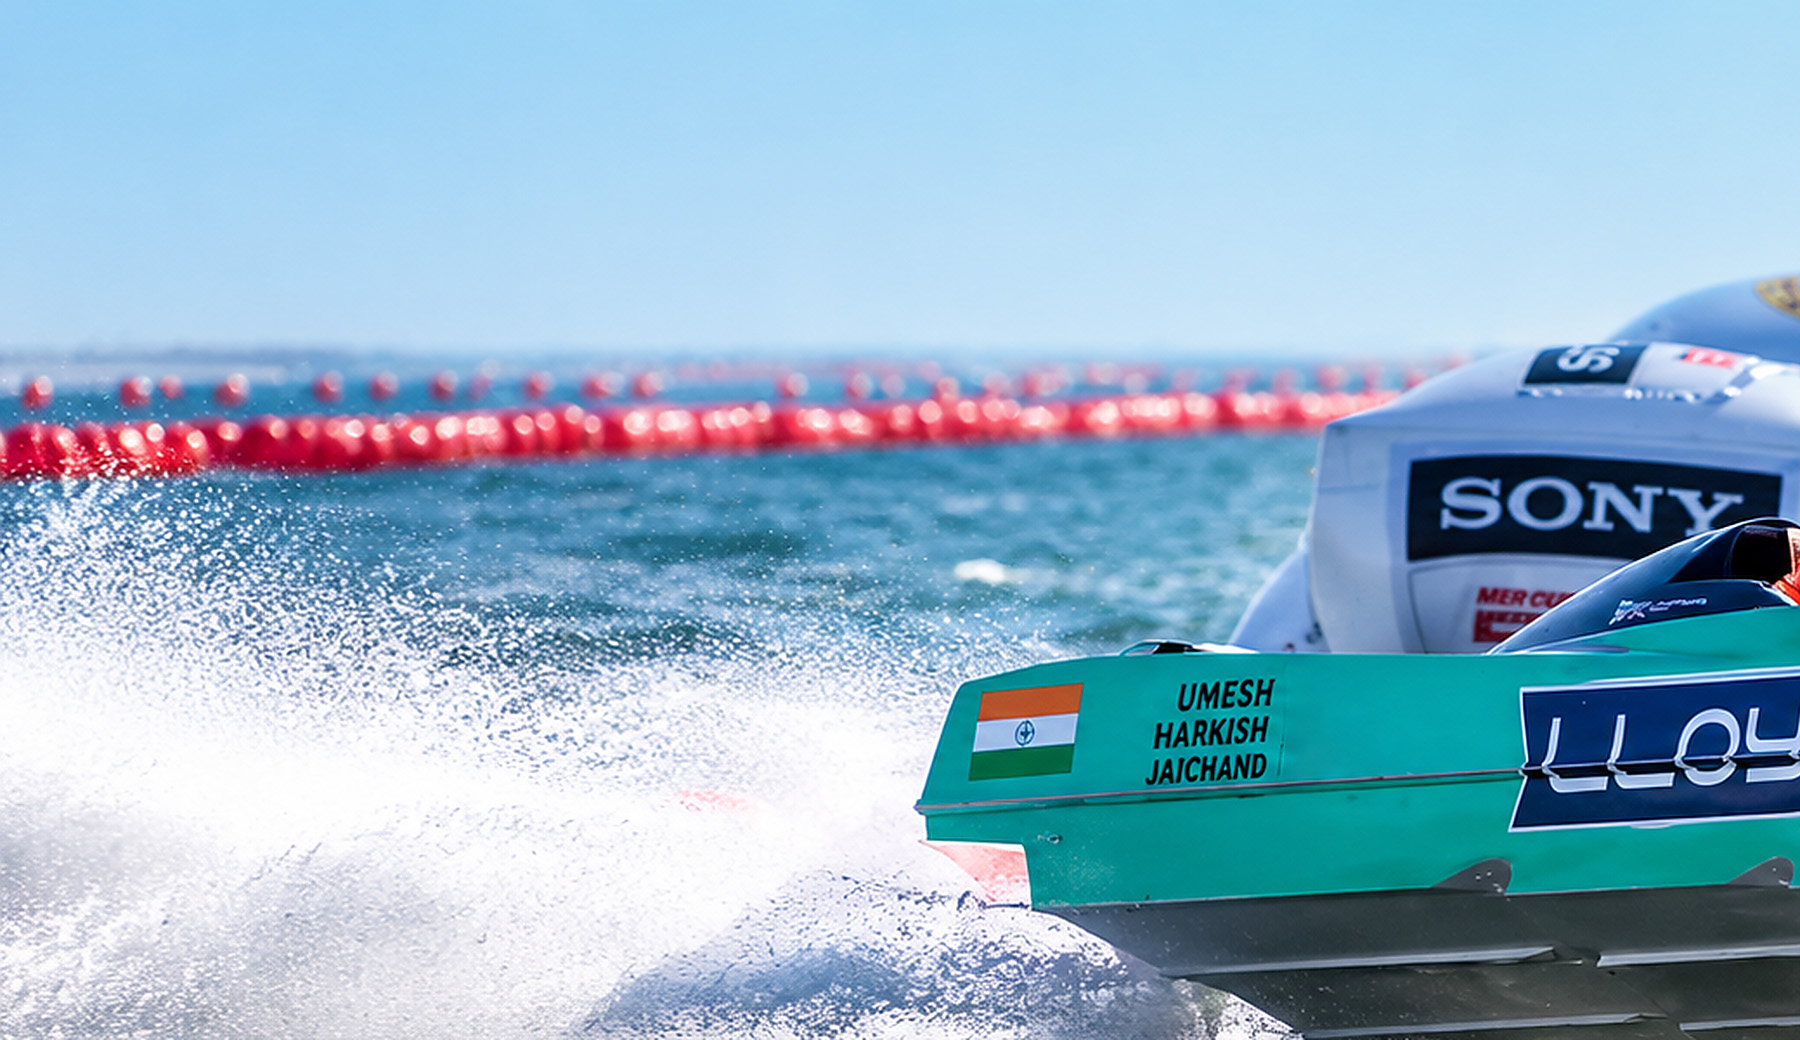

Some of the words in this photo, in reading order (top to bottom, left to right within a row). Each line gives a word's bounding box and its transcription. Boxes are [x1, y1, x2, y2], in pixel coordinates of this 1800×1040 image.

[1440, 476, 1743, 537] SONY
[1476, 586, 1576, 609] MERCU
[1177, 678, 1276, 712] UMESH
[1152, 715, 1270, 750] HARKISH
[1144, 752, 1268, 786] JAICHAND
